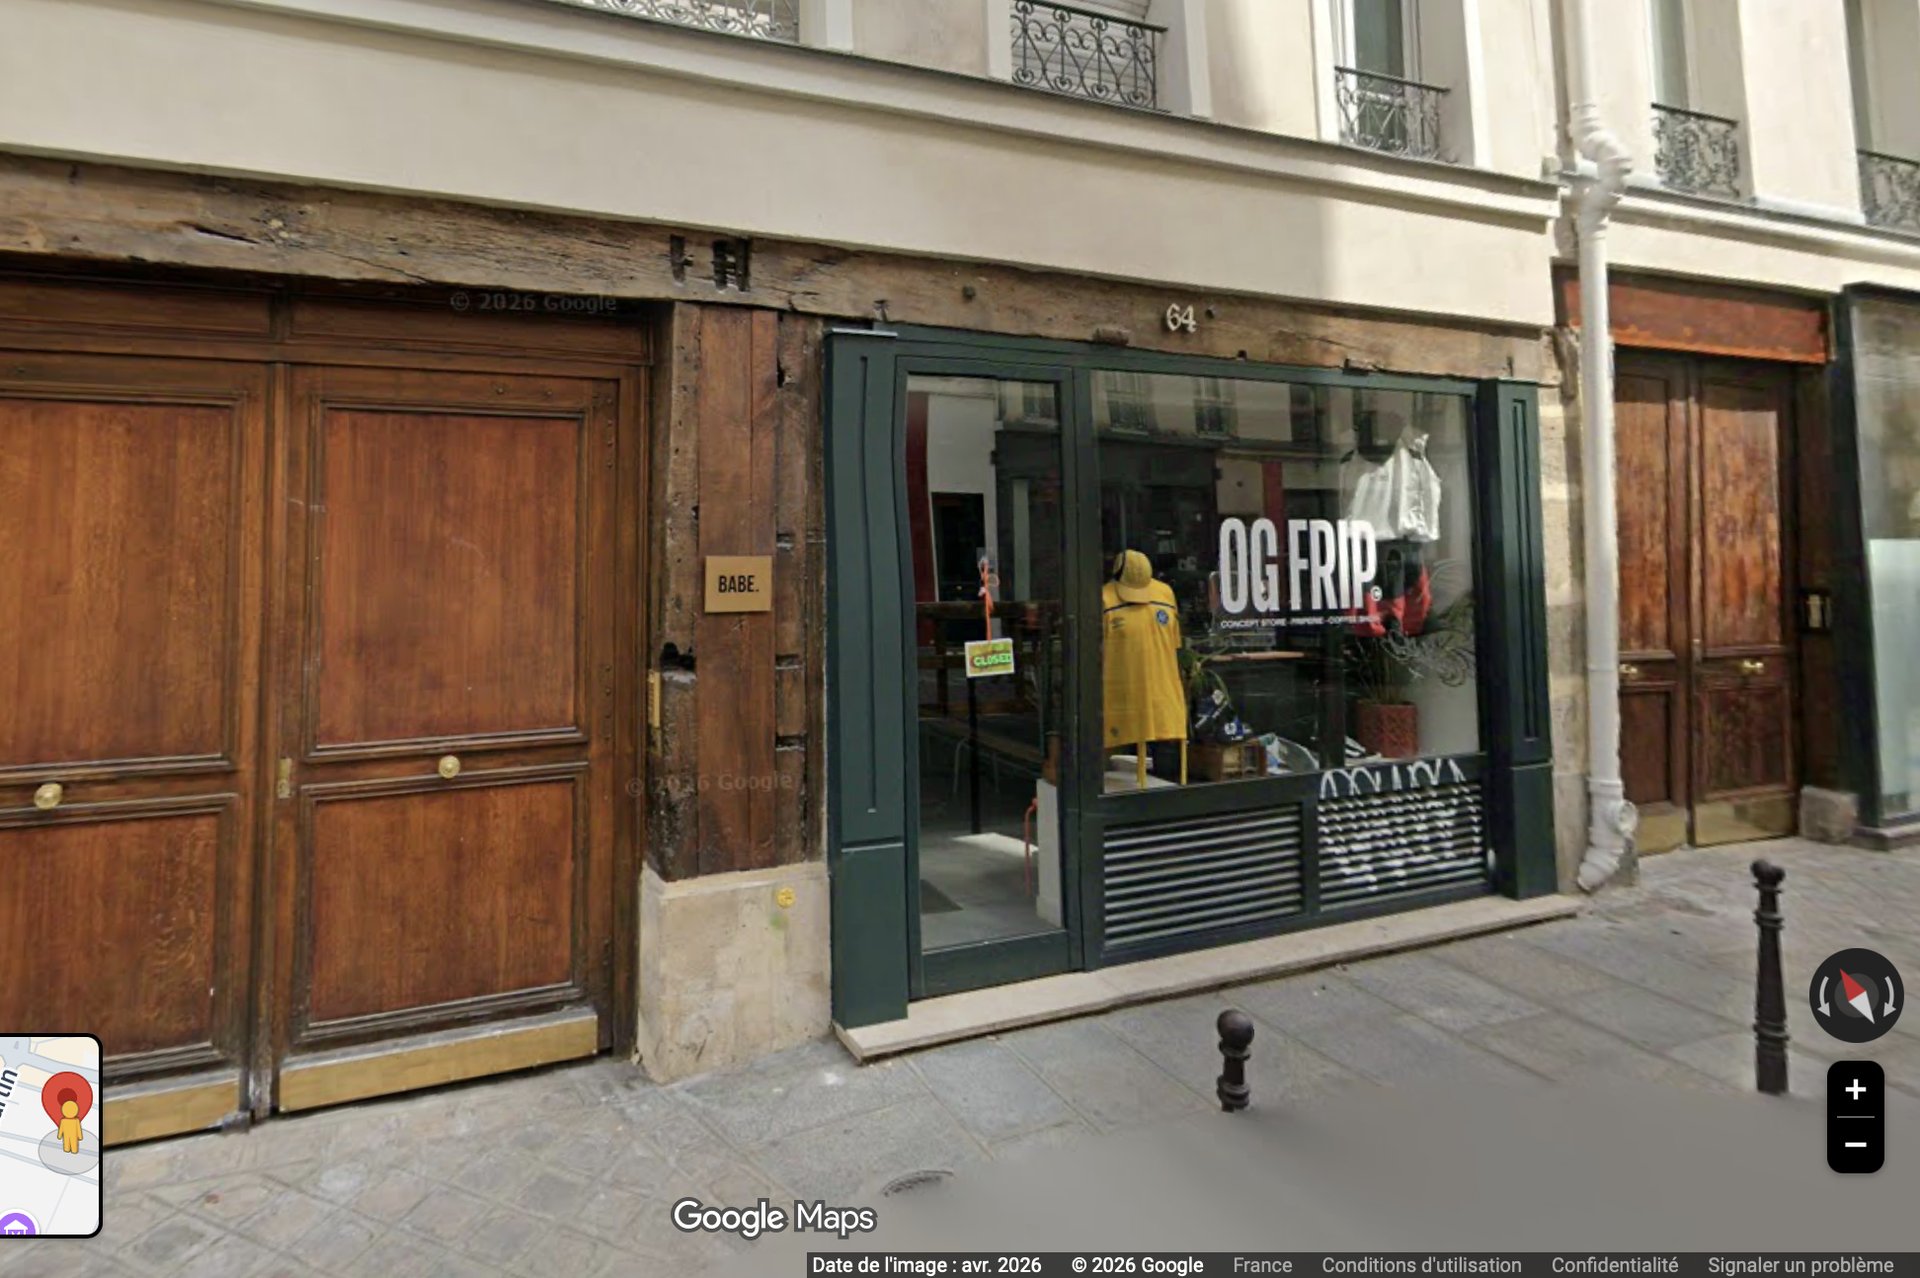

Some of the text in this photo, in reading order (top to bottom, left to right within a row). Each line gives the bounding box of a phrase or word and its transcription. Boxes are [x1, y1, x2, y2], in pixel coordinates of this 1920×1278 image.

[1166, 303, 1196, 333] 64
[1219, 517, 1280, 614] OG
[1288, 519, 1377, 612] FRIP
[718, 575, 760, 593] BABE.
[1220, 618, 1260, 629] CONCEPT
